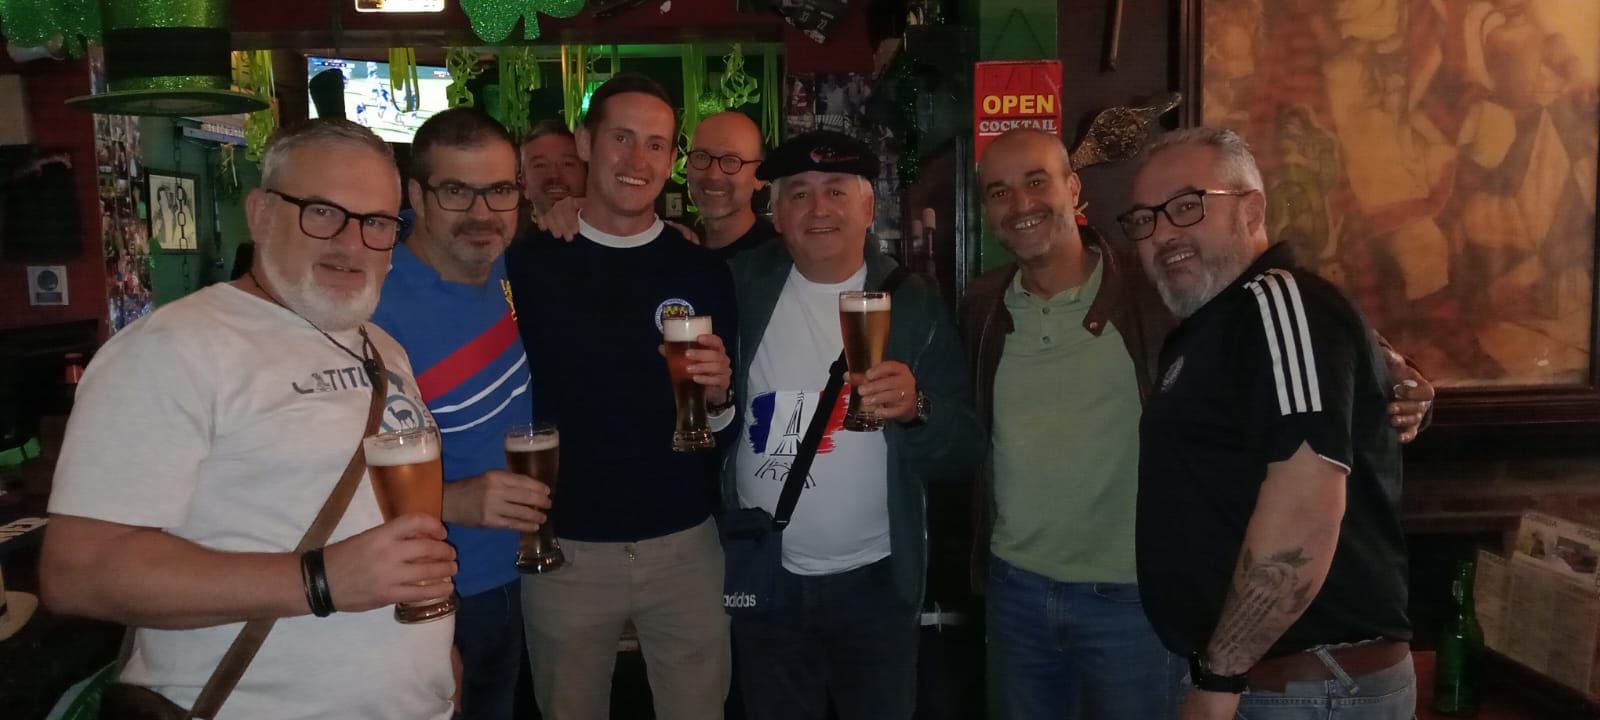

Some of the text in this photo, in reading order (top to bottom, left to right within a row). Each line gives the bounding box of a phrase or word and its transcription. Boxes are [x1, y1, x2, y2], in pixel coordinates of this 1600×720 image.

[982, 94, 1055, 115] OPEN
[979, 120, 1057, 132] COCKTAIL
[723, 591, 757, 608] adidas
